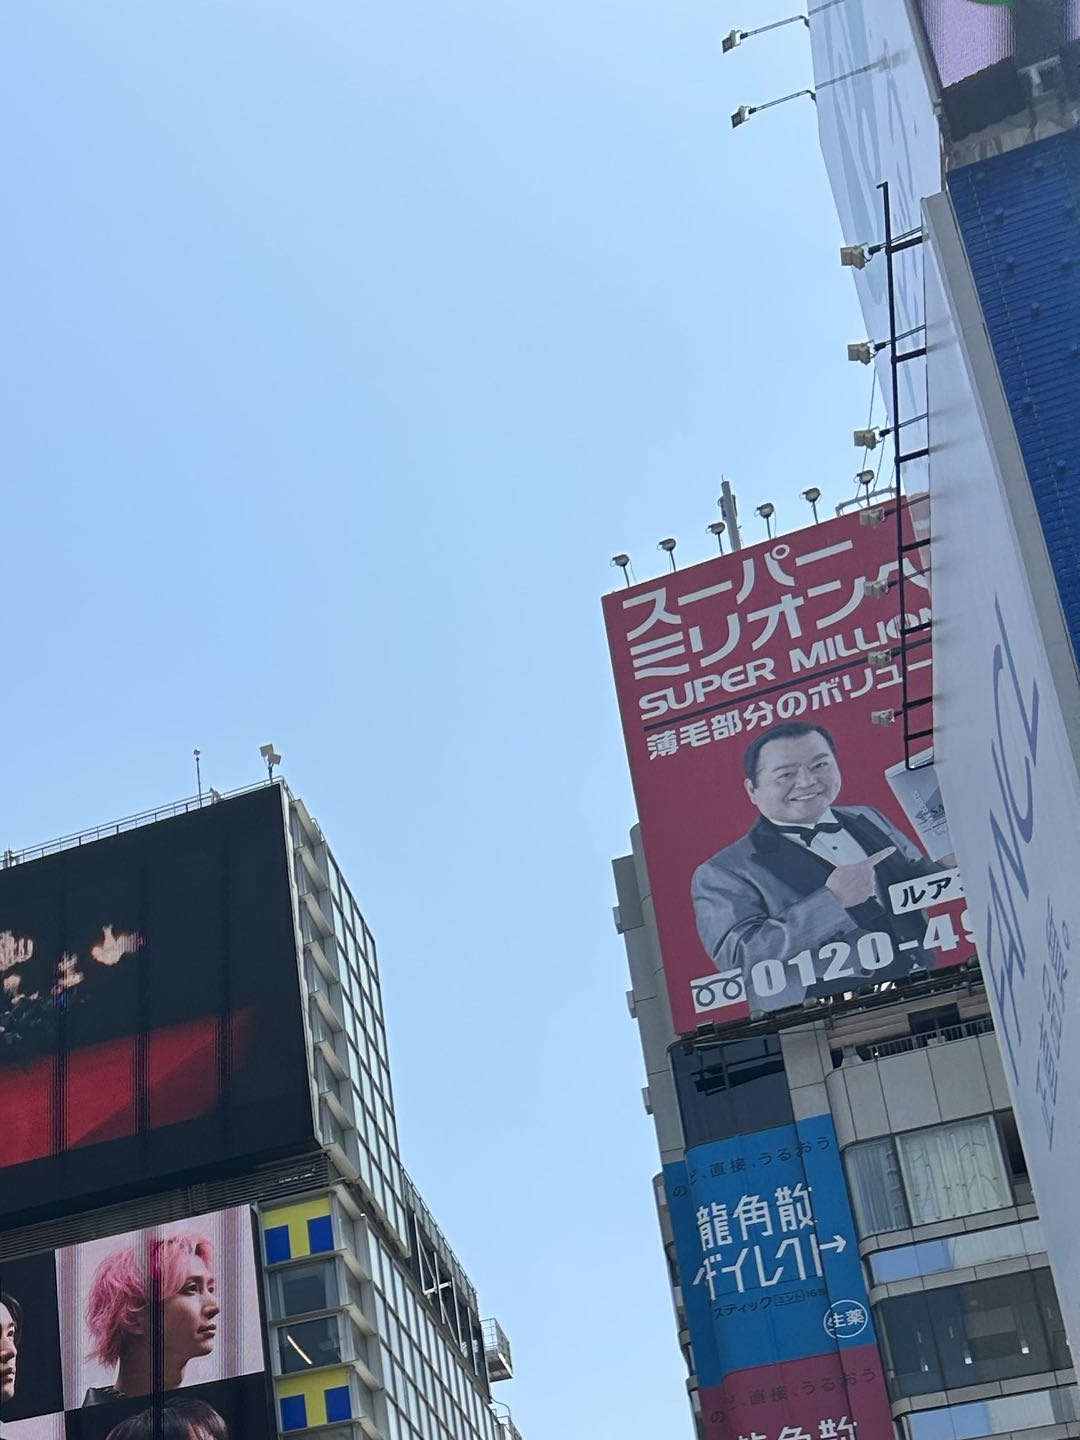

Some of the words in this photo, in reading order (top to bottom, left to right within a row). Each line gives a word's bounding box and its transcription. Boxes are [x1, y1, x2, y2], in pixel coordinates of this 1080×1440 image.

[622, 540, 853, 640] スーパー
[639, 658, 773, 720] SUPER
[987, 592, 1039, 1087] FANCL
[900, 872, 964, 908] ルア
[696, 1183, 818, 1251] 龍角散
[692, 1233, 847, 1300] ダイレクト
[714, 1296, 771, 1320] スティック
[827, 1309, 865, 1332] 生薬
